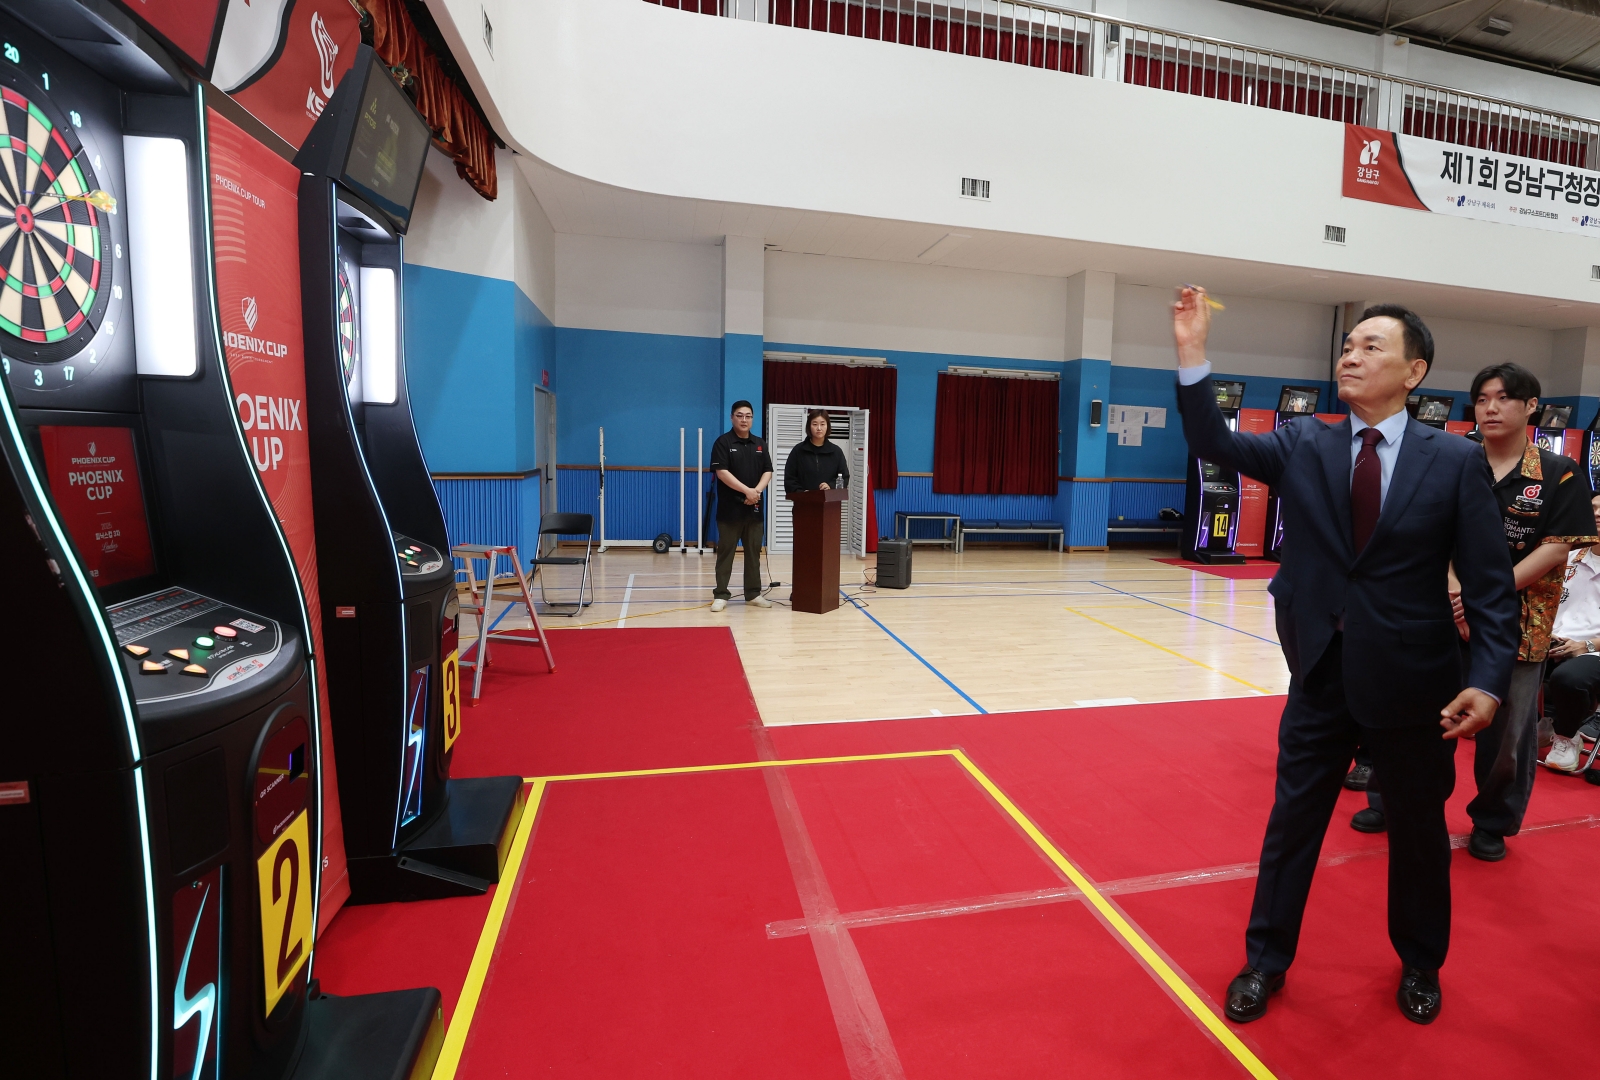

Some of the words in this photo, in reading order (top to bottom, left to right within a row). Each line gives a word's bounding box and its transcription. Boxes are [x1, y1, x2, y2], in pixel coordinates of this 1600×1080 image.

[4, 43, 20, 63] 20
[42, 72, 49, 90] 1
[306, 86, 327, 117] KS
[70, 110, 82, 128] 18
[94, 154, 102, 170] 4
[1357, 166, 1380, 179] 강남구
[1440, 149, 1499, 191] 제1회
[1504, 161, 1600, 208] 강남구청장
[215, 173, 240, 196] PHOENIX
[240, 188, 251, 201] CUP
[252, 195, 266, 209] TOUR
[115, 243, 122, 259] 6
[112, 285, 122, 300] 10
[104, 320, 114, 336] 15
[223, 331, 265, 354] HOENIX
[266, 341, 288, 358] CUP
[89, 348, 97, 364] 2
[34, 368, 43, 386] 3
[63, 365, 75, 381] 17
[236, 392, 302, 431] OENIX
[71, 457, 102, 465] PHOENIX
[102, 456, 116, 464] CUP
[252, 436, 284, 472] UP
[68, 469, 124, 486] PHOENIX
[86, 485, 113, 501] CUP
[1215, 516, 1228, 536] 14
[1504, 516, 1519, 526] TEAM
[446, 659, 457, 740] 3
[272, 838, 303, 990] 2
